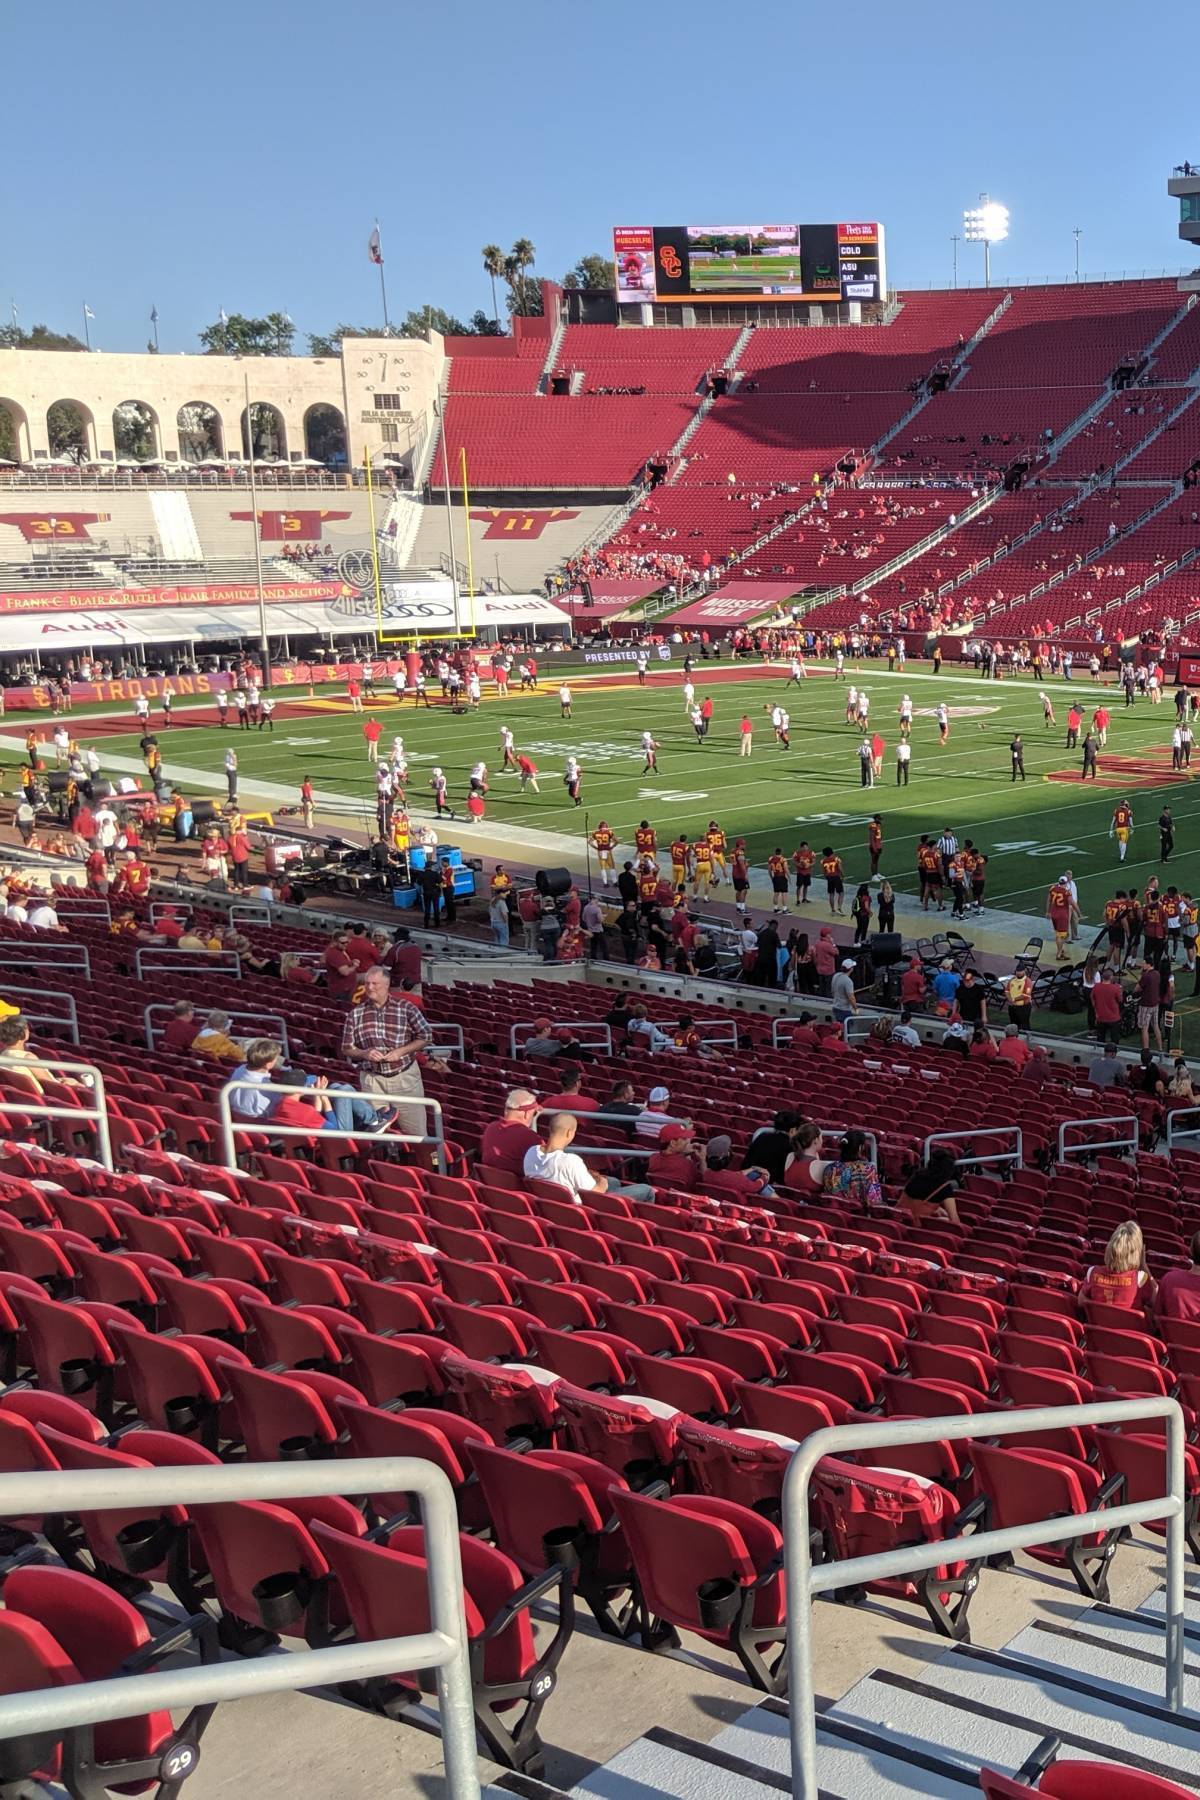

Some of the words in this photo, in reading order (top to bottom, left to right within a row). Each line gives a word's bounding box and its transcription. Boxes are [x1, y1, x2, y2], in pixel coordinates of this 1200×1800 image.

[841, 263, 857, 272] ASU
[30, 520, 76, 535] 33
[283, 518, 302, 532] 3
[503, 518, 535, 531] 11
[6, 596, 49, 609] FRANK
[69, 595, 105, 607] BLAIR
[108, 594, 119, 606] &
[122, 592, 157, 605] RUTH
[212, 588, 251, 601] FAMILY
[290, 586, 335, 598] SECTION
[701, 598, 779, 610] MUSCLE
[485, 600, 549, 613] Audi
[697, 608, 750, 618] MILK
[41, 619, 129, 635] Audi
[584, 651, 638, 664] PRESENTED
[92, 675, 211, 701] TROJANS
[795, 811, 875, 828] 50
[1118, 812, 1126, 823] 8
[636, 833, 652, 846] 24
[708, 833, 723, 845] 36
[672, 846, 684, 858] 15
[695, 847, 710, 860] 38
[990, 839, 1079, 858] 40
[131, 870, 142, 885] 7
[640, 882, 657, 896] 47
[1050, 891, 1064, 906] 72
[534, 1675, 553, 1696] 28
[169, 1750, 192, 1776] 29
